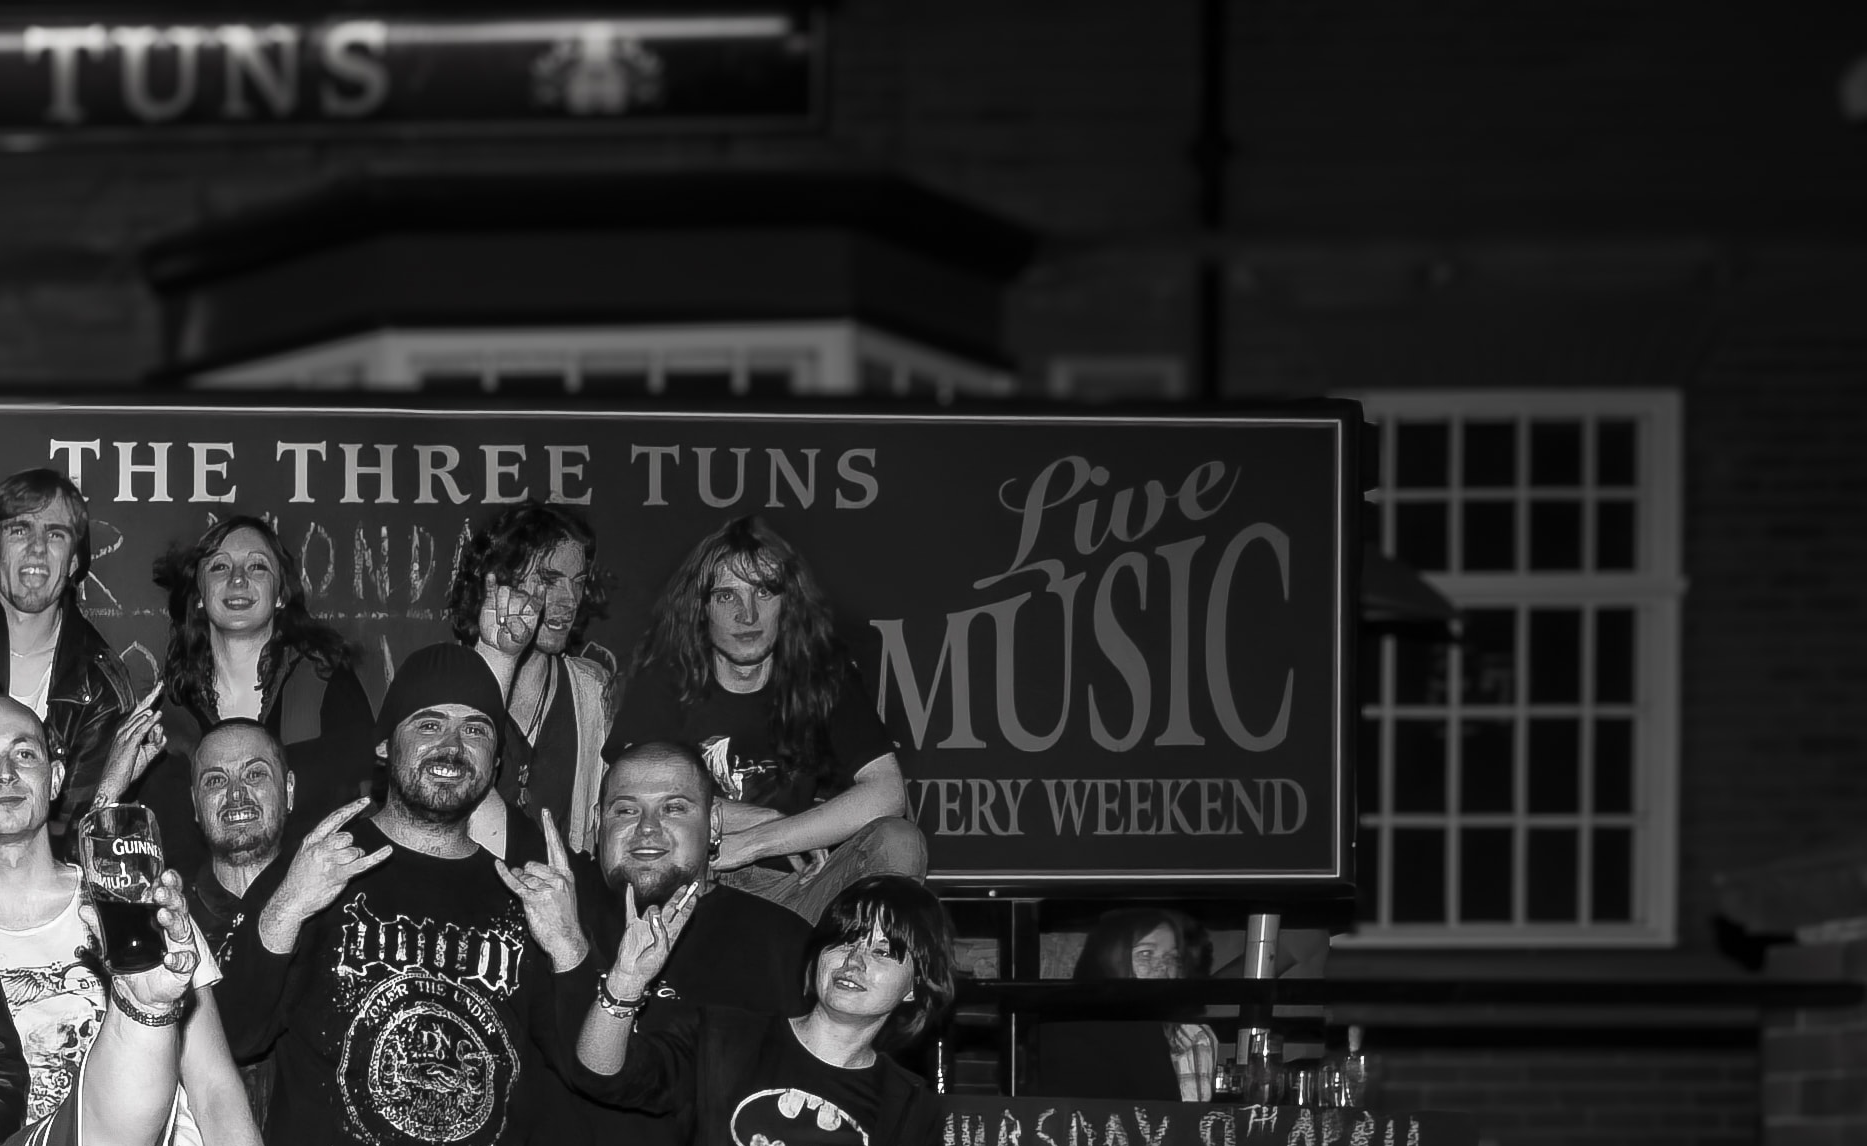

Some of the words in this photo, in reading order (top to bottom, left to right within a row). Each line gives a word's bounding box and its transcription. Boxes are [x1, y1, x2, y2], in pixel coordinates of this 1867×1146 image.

[22, 22, 391, 119] TUNS
[50, 439, 237, 502] THE
[276, 441, 593, 506] THREE
[630, 444, 879, 510] TUNS
[972, 455, 1242, 590] Live
[869, 522, 1295, 753] MUSIC
[1040, 778, 1308, 837] WEEKEND
